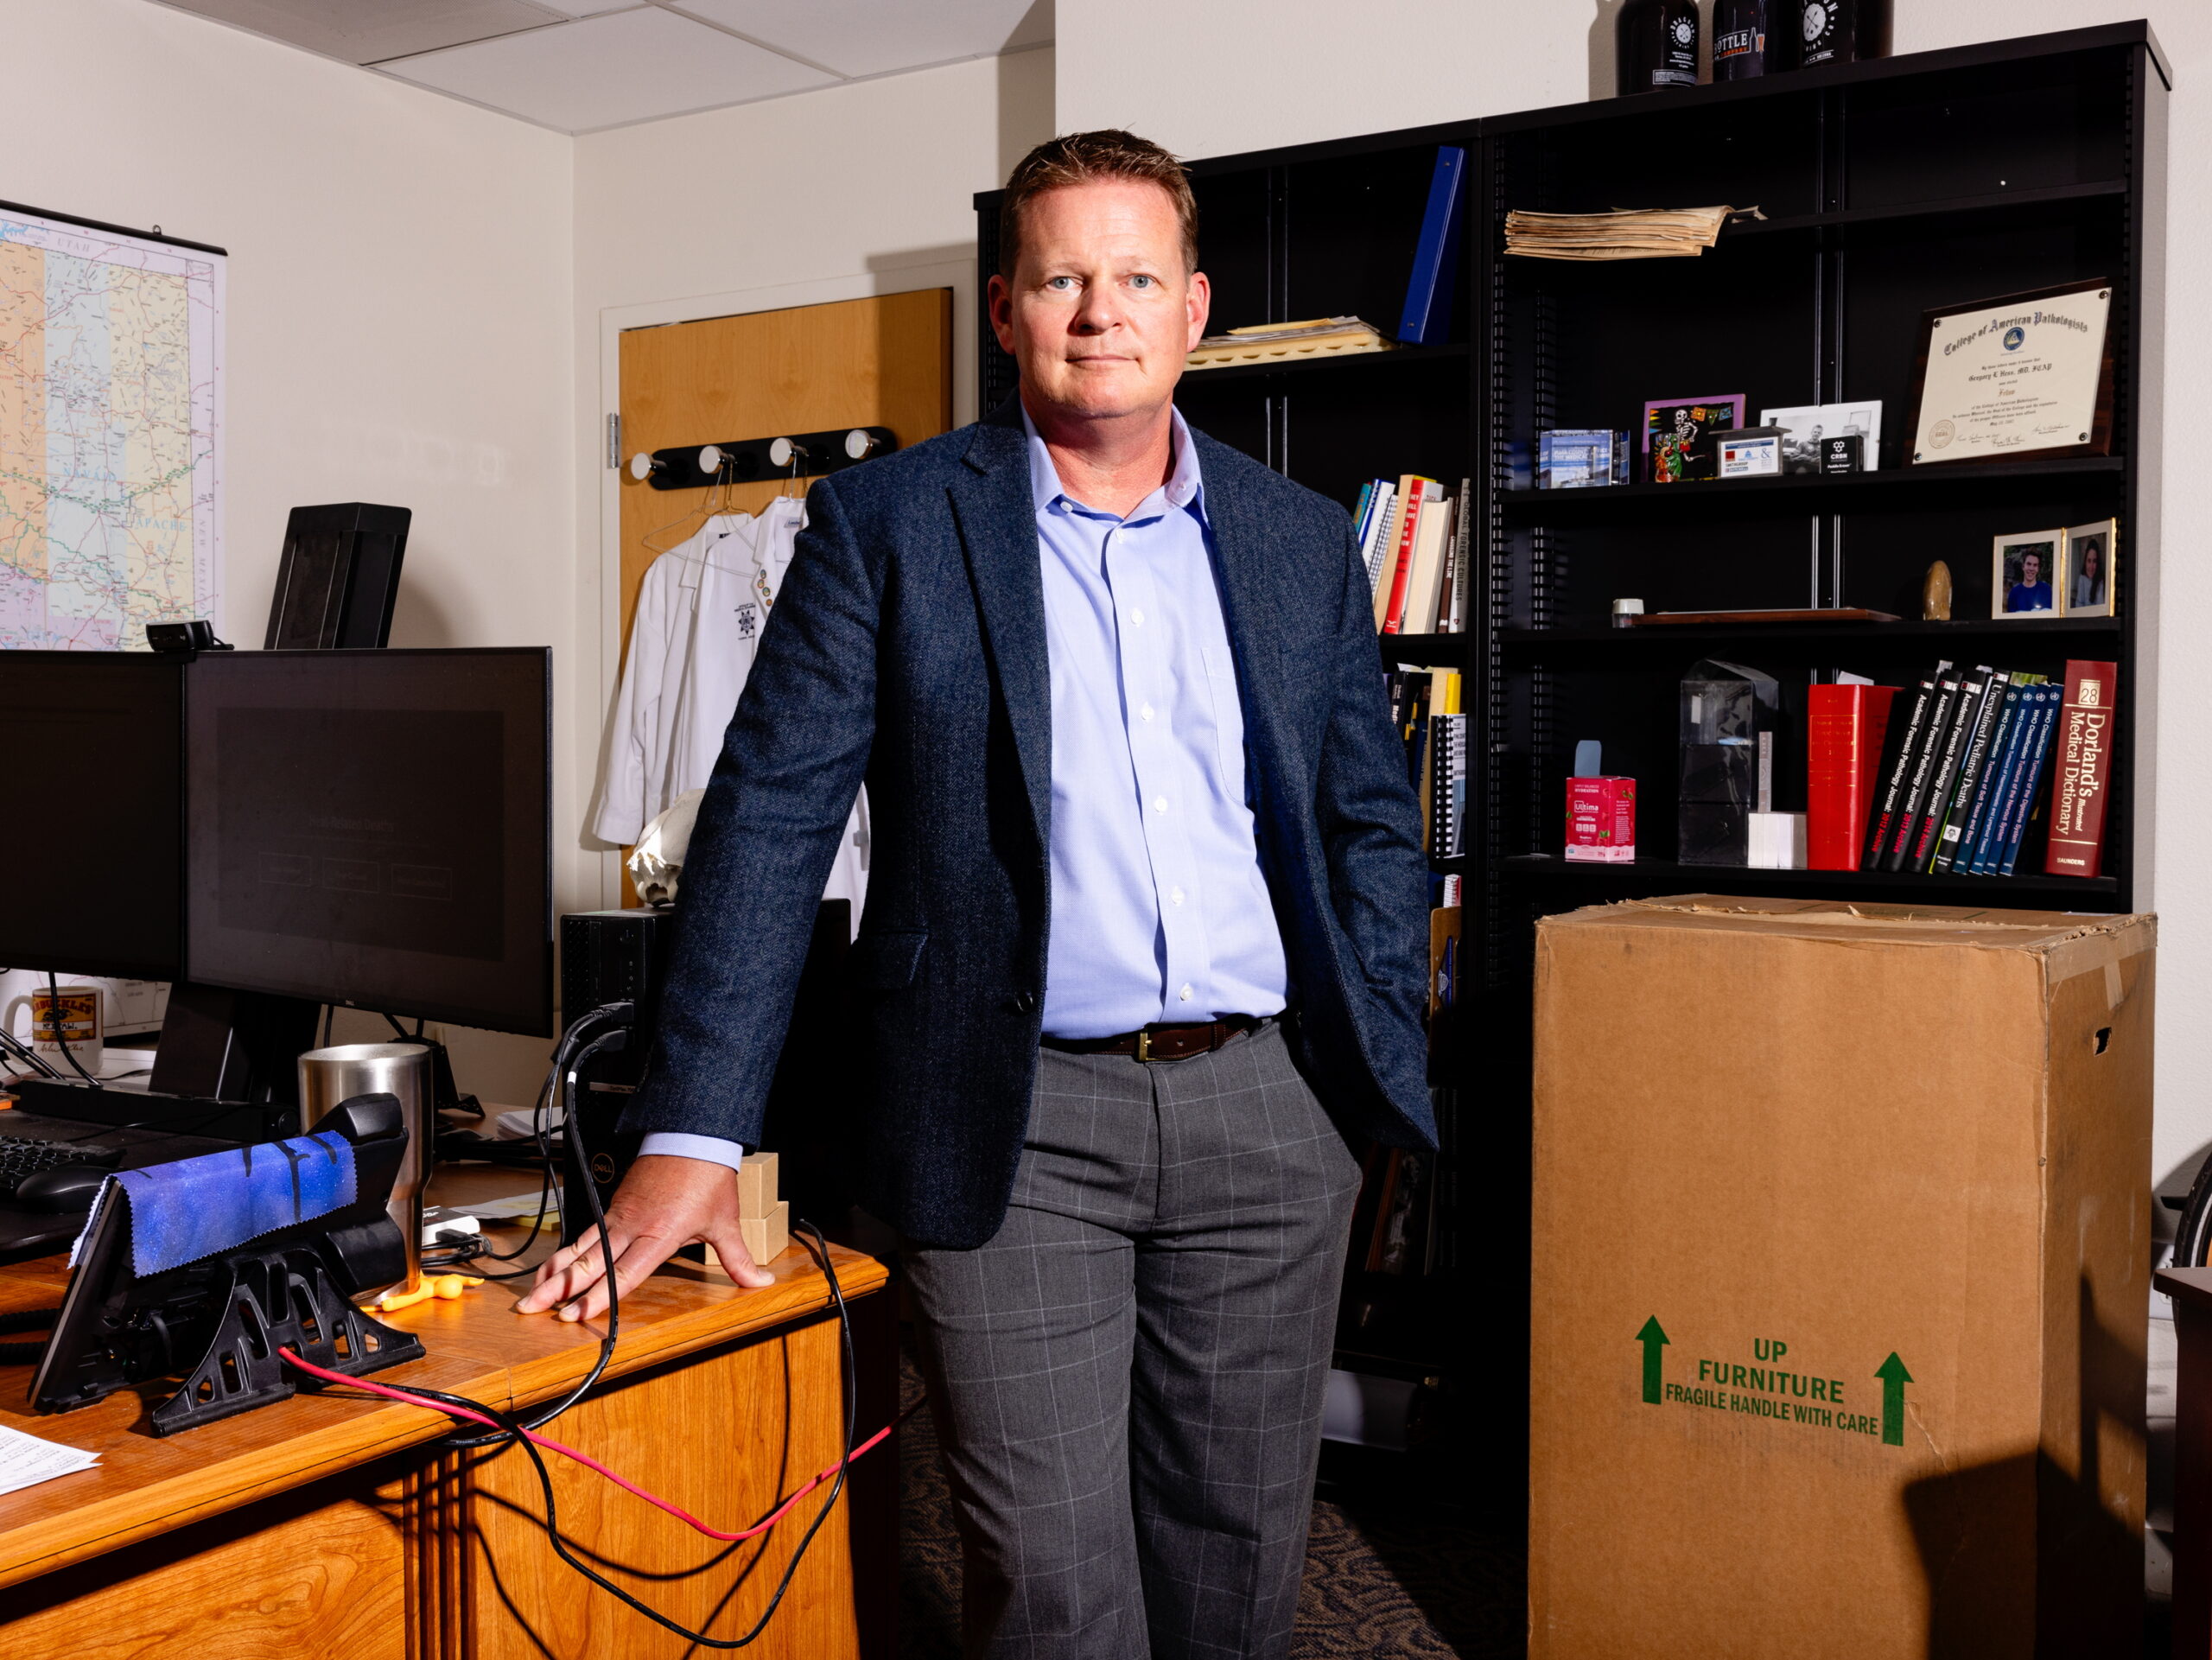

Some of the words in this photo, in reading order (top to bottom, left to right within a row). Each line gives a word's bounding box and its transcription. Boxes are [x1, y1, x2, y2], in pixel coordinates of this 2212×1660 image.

[57, 237, 91, 252] UTAH
[1944, 332, 1976, 356] College
[1978, 325, 1988, 336] of
[1988, 315, 2031, 334] American
[2034, 311, 2088, 333] Pathologists
[1968, 373, 1992, 382] Gregory
[136, 518, 188, 532] APACHE
[1458, 531, 1468, 565] FORENSIC
[1456, 567, 1465, 602] CULTURES
[1911, 694, 1927, 726] Academic
[1933, 694, 1948, 726] Academic
[1956, 693, 1972, 726] Academic
[2081, 688, 2099, 704] 28
[1978, 684, 2002, 738] Unexplained
[2002, 709, 2011, 723] WHO
[2031, 709, 2040, 724] WHO
[2044, 709, 2053, 723] WHO
[1903, 726, 1917, 754] Forensic
[1923, 726, 1938, 754] Forensic
[1947, 727, 1962, 755] Forensic
[1991, 723, 2006, 758] Classification
[2010, 722, 2022, 749] Classification
[2021, 725, 2036, 759] Classification
[2035, 724, 2049, 759] Classification
[2066, 711, 2086, 763] Medical
[1966, 739, 1985, 777] Pediatric
[2080, 713, 2106, 798] Dorland's
[1891, 754, 1909, 786] Pathology
[1913, 754, 1929, 786] Pathology
[1935, 756, 1953, 789] Pathology
[2013, 760, 2025, 783] Tumours
[2028, 760, 2039, 782] Tumours
[1575, 802, 1599, 811] Ultima
[1884, 786, 1897, 812] Journal:
[1905, 786, 1919, 813] Journal:
[1928, 789, 1942, 817] Journal:
[1956, 778, 1973, 808] Deaths
[2056, 766, 2080, 836] Dictionary
[2017, 798, 2028, 824] Digestive
[2075, 798, 2087, 832] Illustrated
[1872, 828, 1885, 852] Archive
[1893, 829, 1906, 853] Archive
[1916, 833, 1929, 858] Archive
[1997, 822, 2007, 842] System
[2012, 824, 2021, 843] System
[2056, 856, 2086, 867] SAUNDERS
[594, 1163, 612, 1173] DELL
[1754, 1338, 1788, 1363] UP
[1699, 1359, 1845, 1403] FURNITURE
[1666, 1383, 1727, 1409] FRAGILE
[1730, 1394, 1790, 1421] HANDLE
[1793, 1404, 1833, 1428] WITH
[1836, 1411, 1878, 1435] CARE
